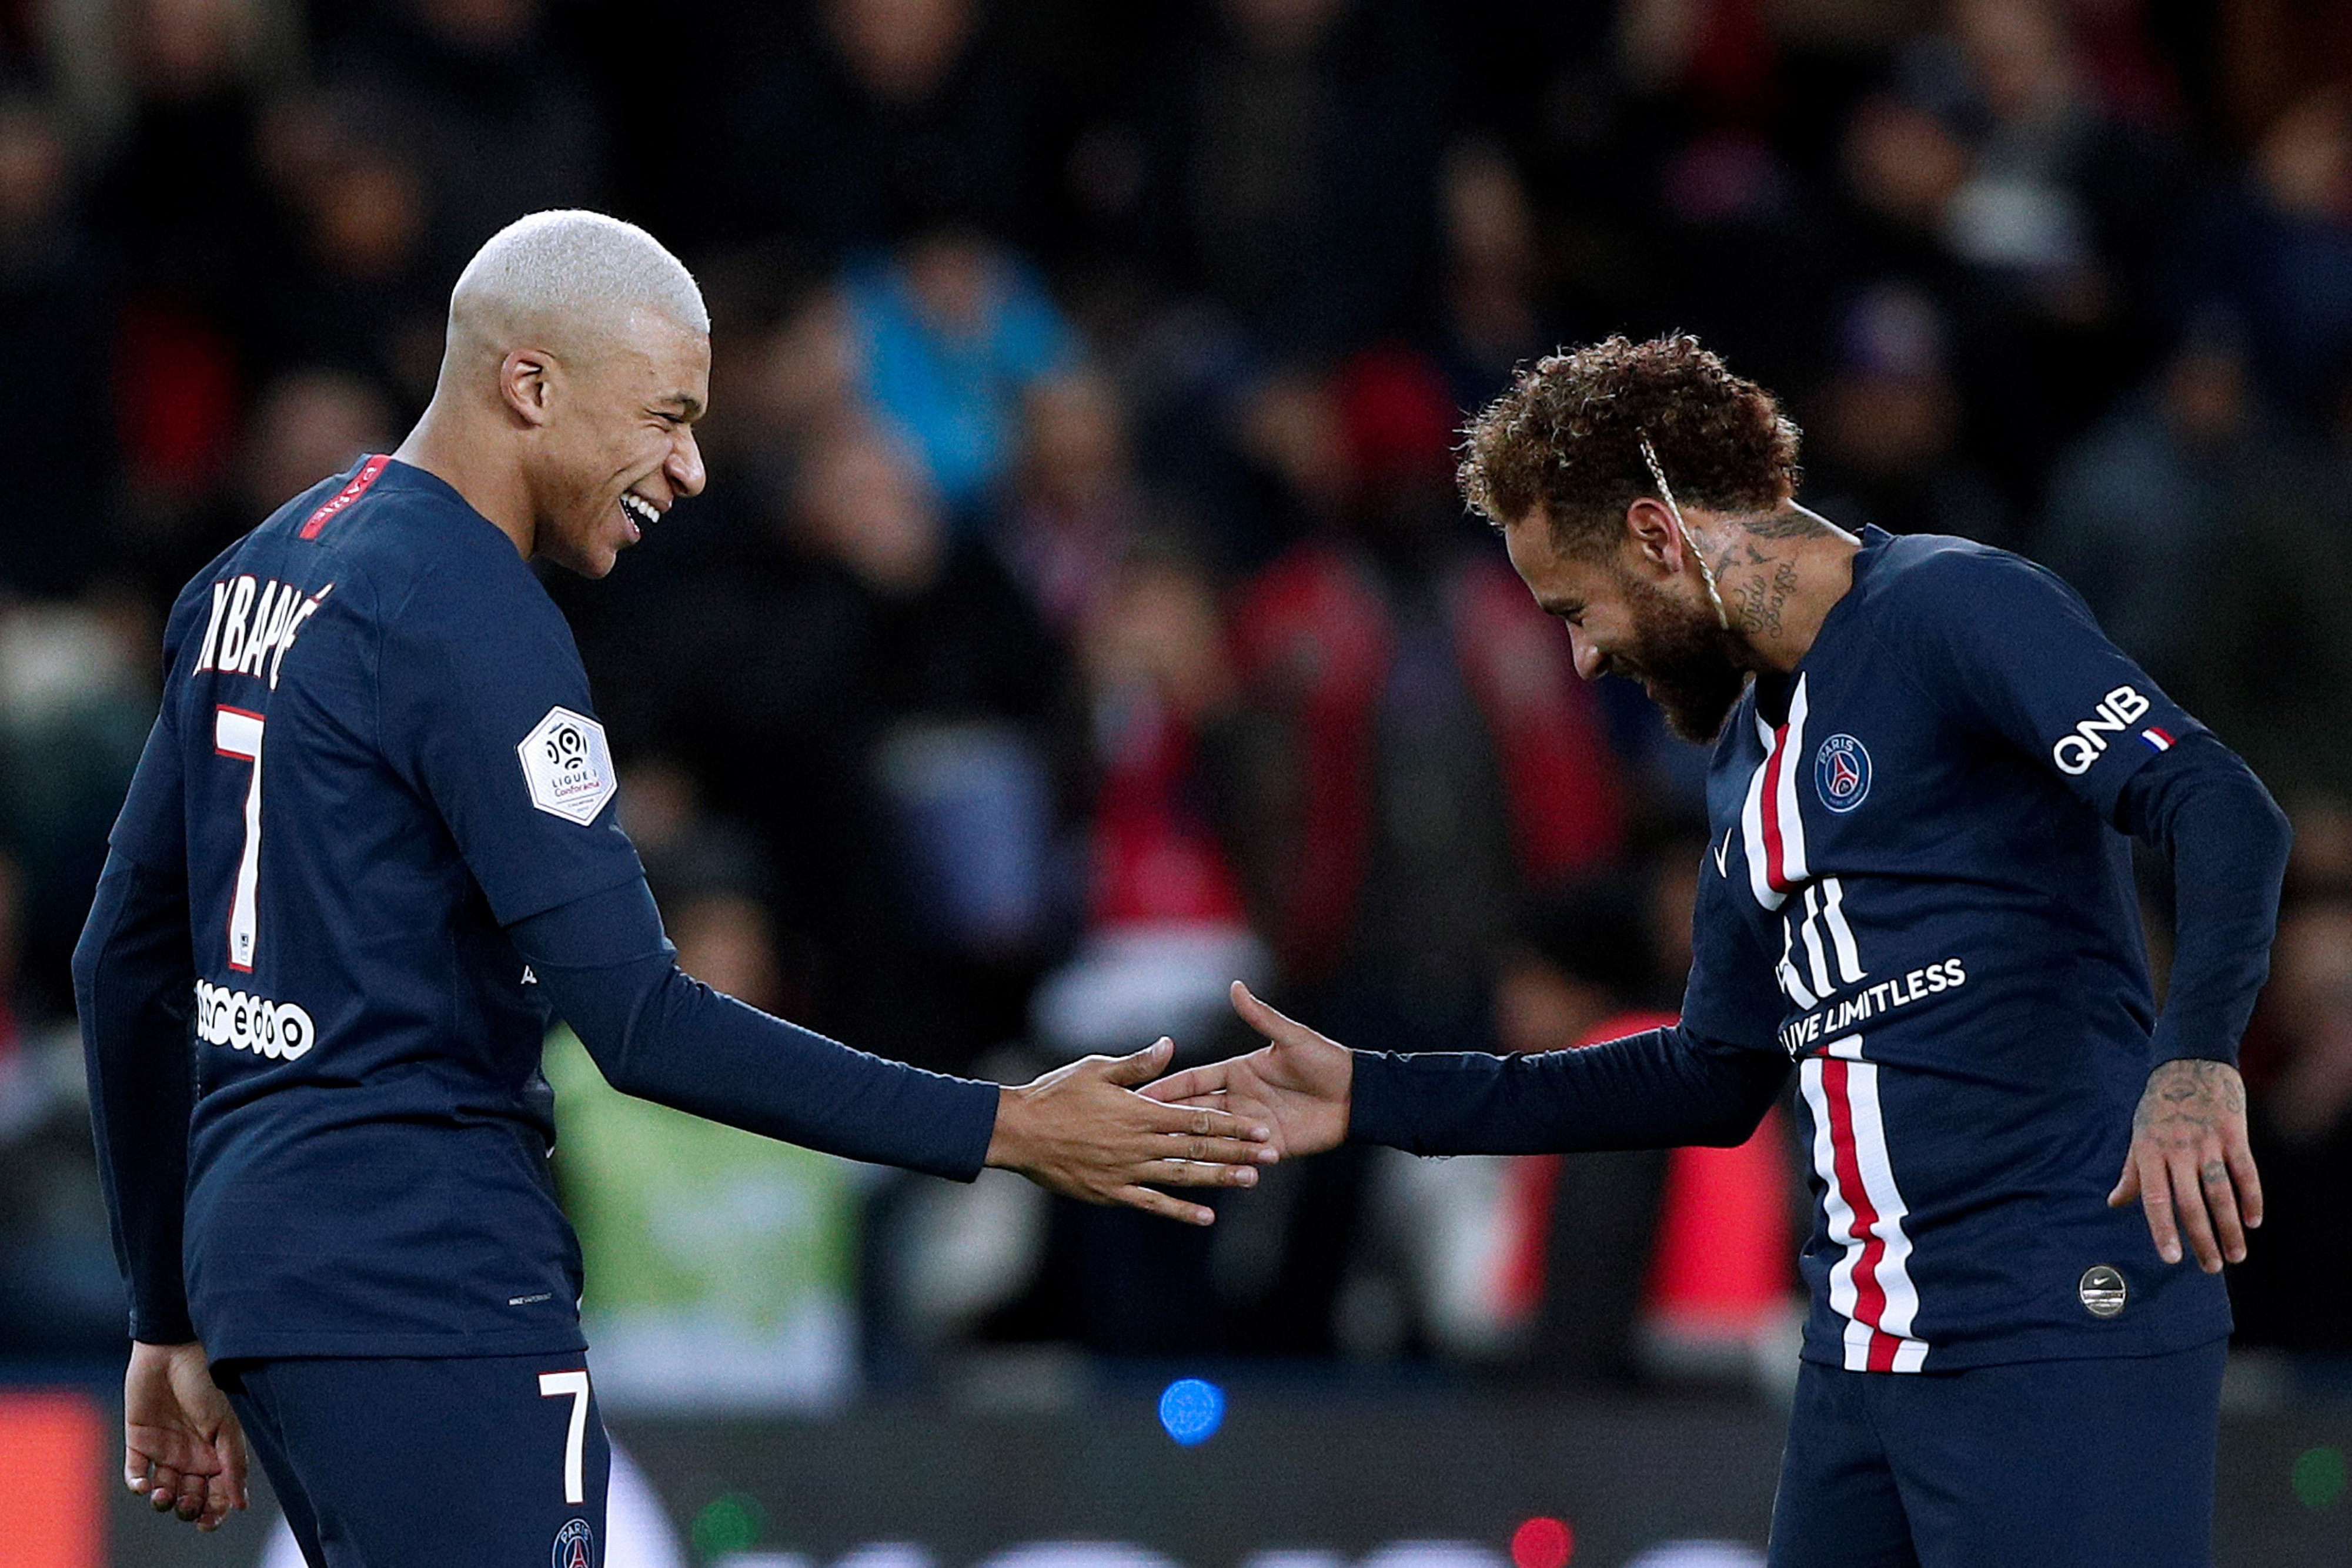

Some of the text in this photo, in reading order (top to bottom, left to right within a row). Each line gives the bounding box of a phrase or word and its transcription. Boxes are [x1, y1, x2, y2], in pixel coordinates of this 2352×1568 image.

[1819, 738, 1854, 764] PARIS
[2053, 686, 2150, 775] QNB
[552, 771, 588, 788] LIGUE
[214, 704, 266, 972] 7
[1823, 958, 1966, 1034] LIMITLESS
[537, 1370, 589, 1506] 7
[560, 1522, 590, 1544] PARIS
